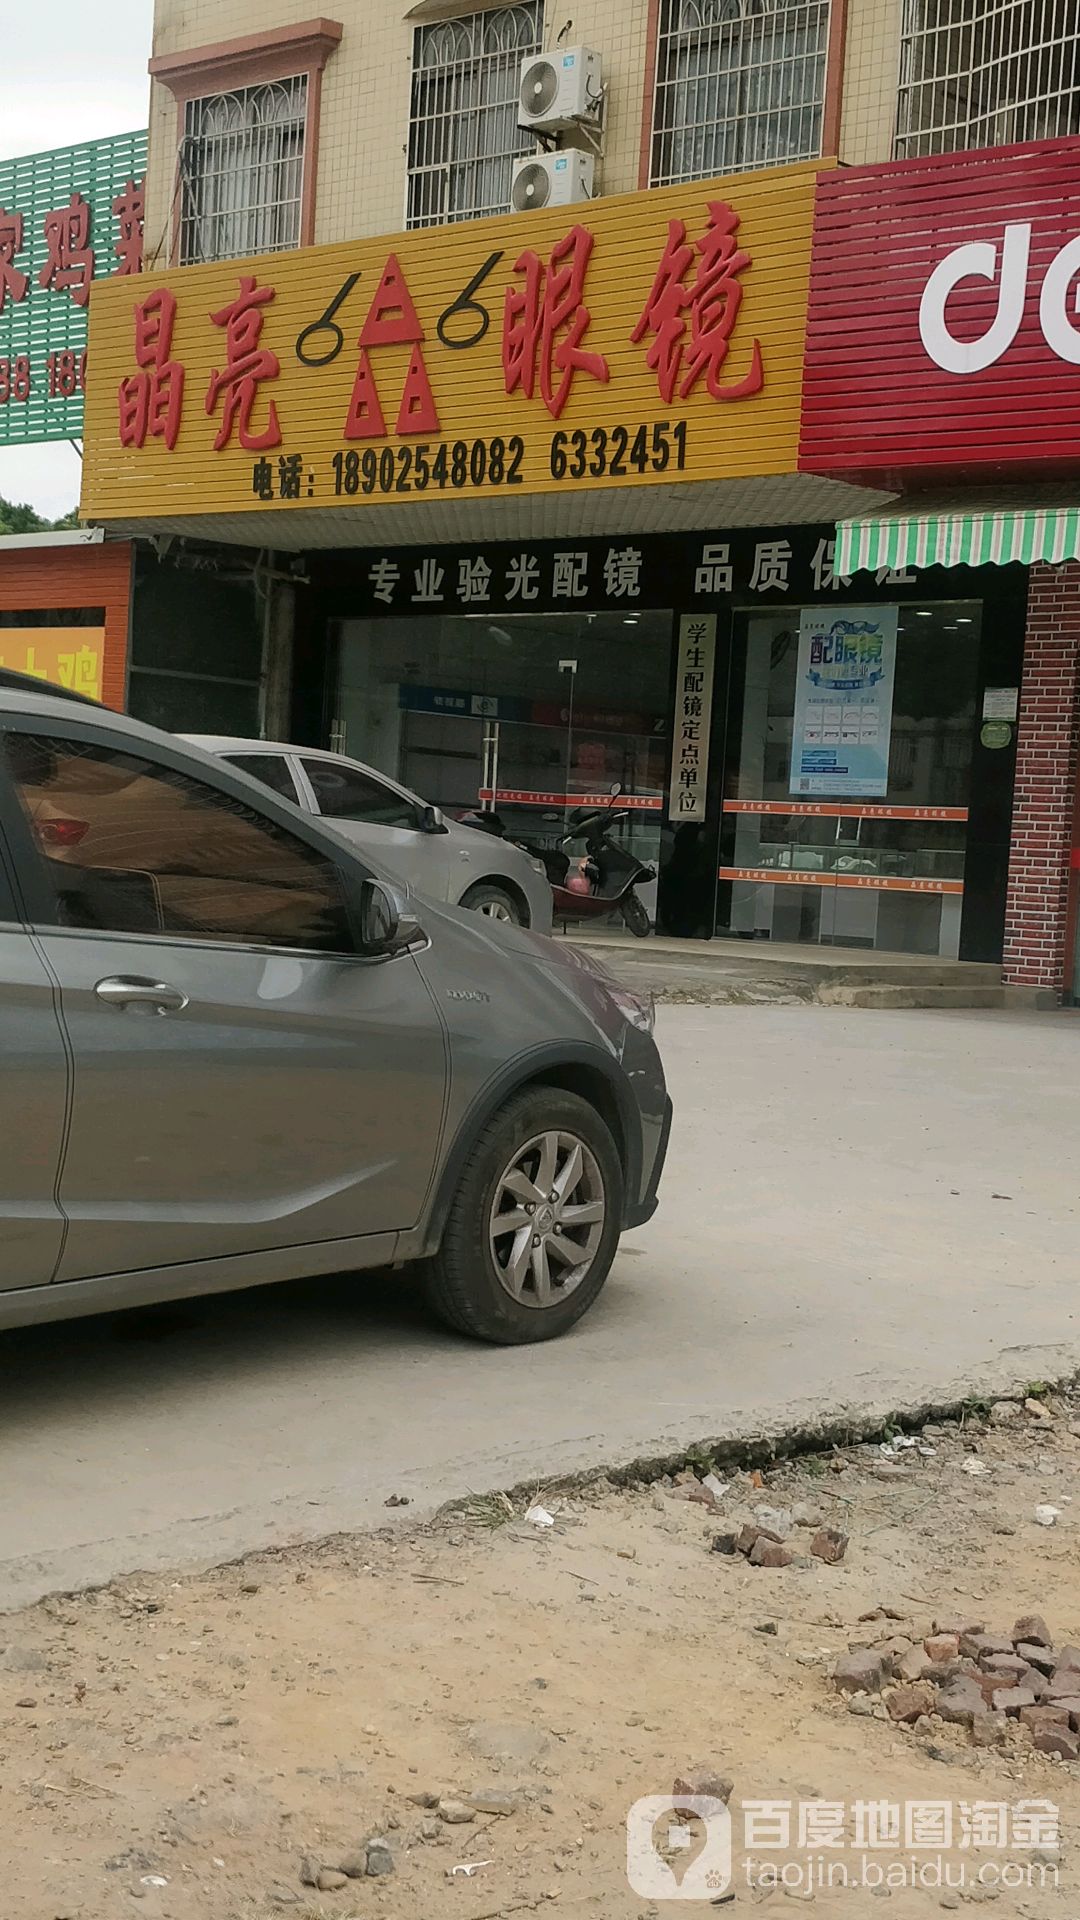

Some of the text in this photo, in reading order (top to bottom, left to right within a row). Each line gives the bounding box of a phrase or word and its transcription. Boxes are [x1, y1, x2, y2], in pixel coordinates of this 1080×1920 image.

[118, 200, 765, 451] 晶亮 眼镜
[46, 345, 88, 397] 18
[331, 435, 525, 495] 18902548082
[550, 420, 688, 480] 6332451
[368, 538, 918, 605] 专业验光配镜 品质保
[810, 634, 883, 664] 配眼镜
[678, 622, 707, 813] 学生配镜定点单位
